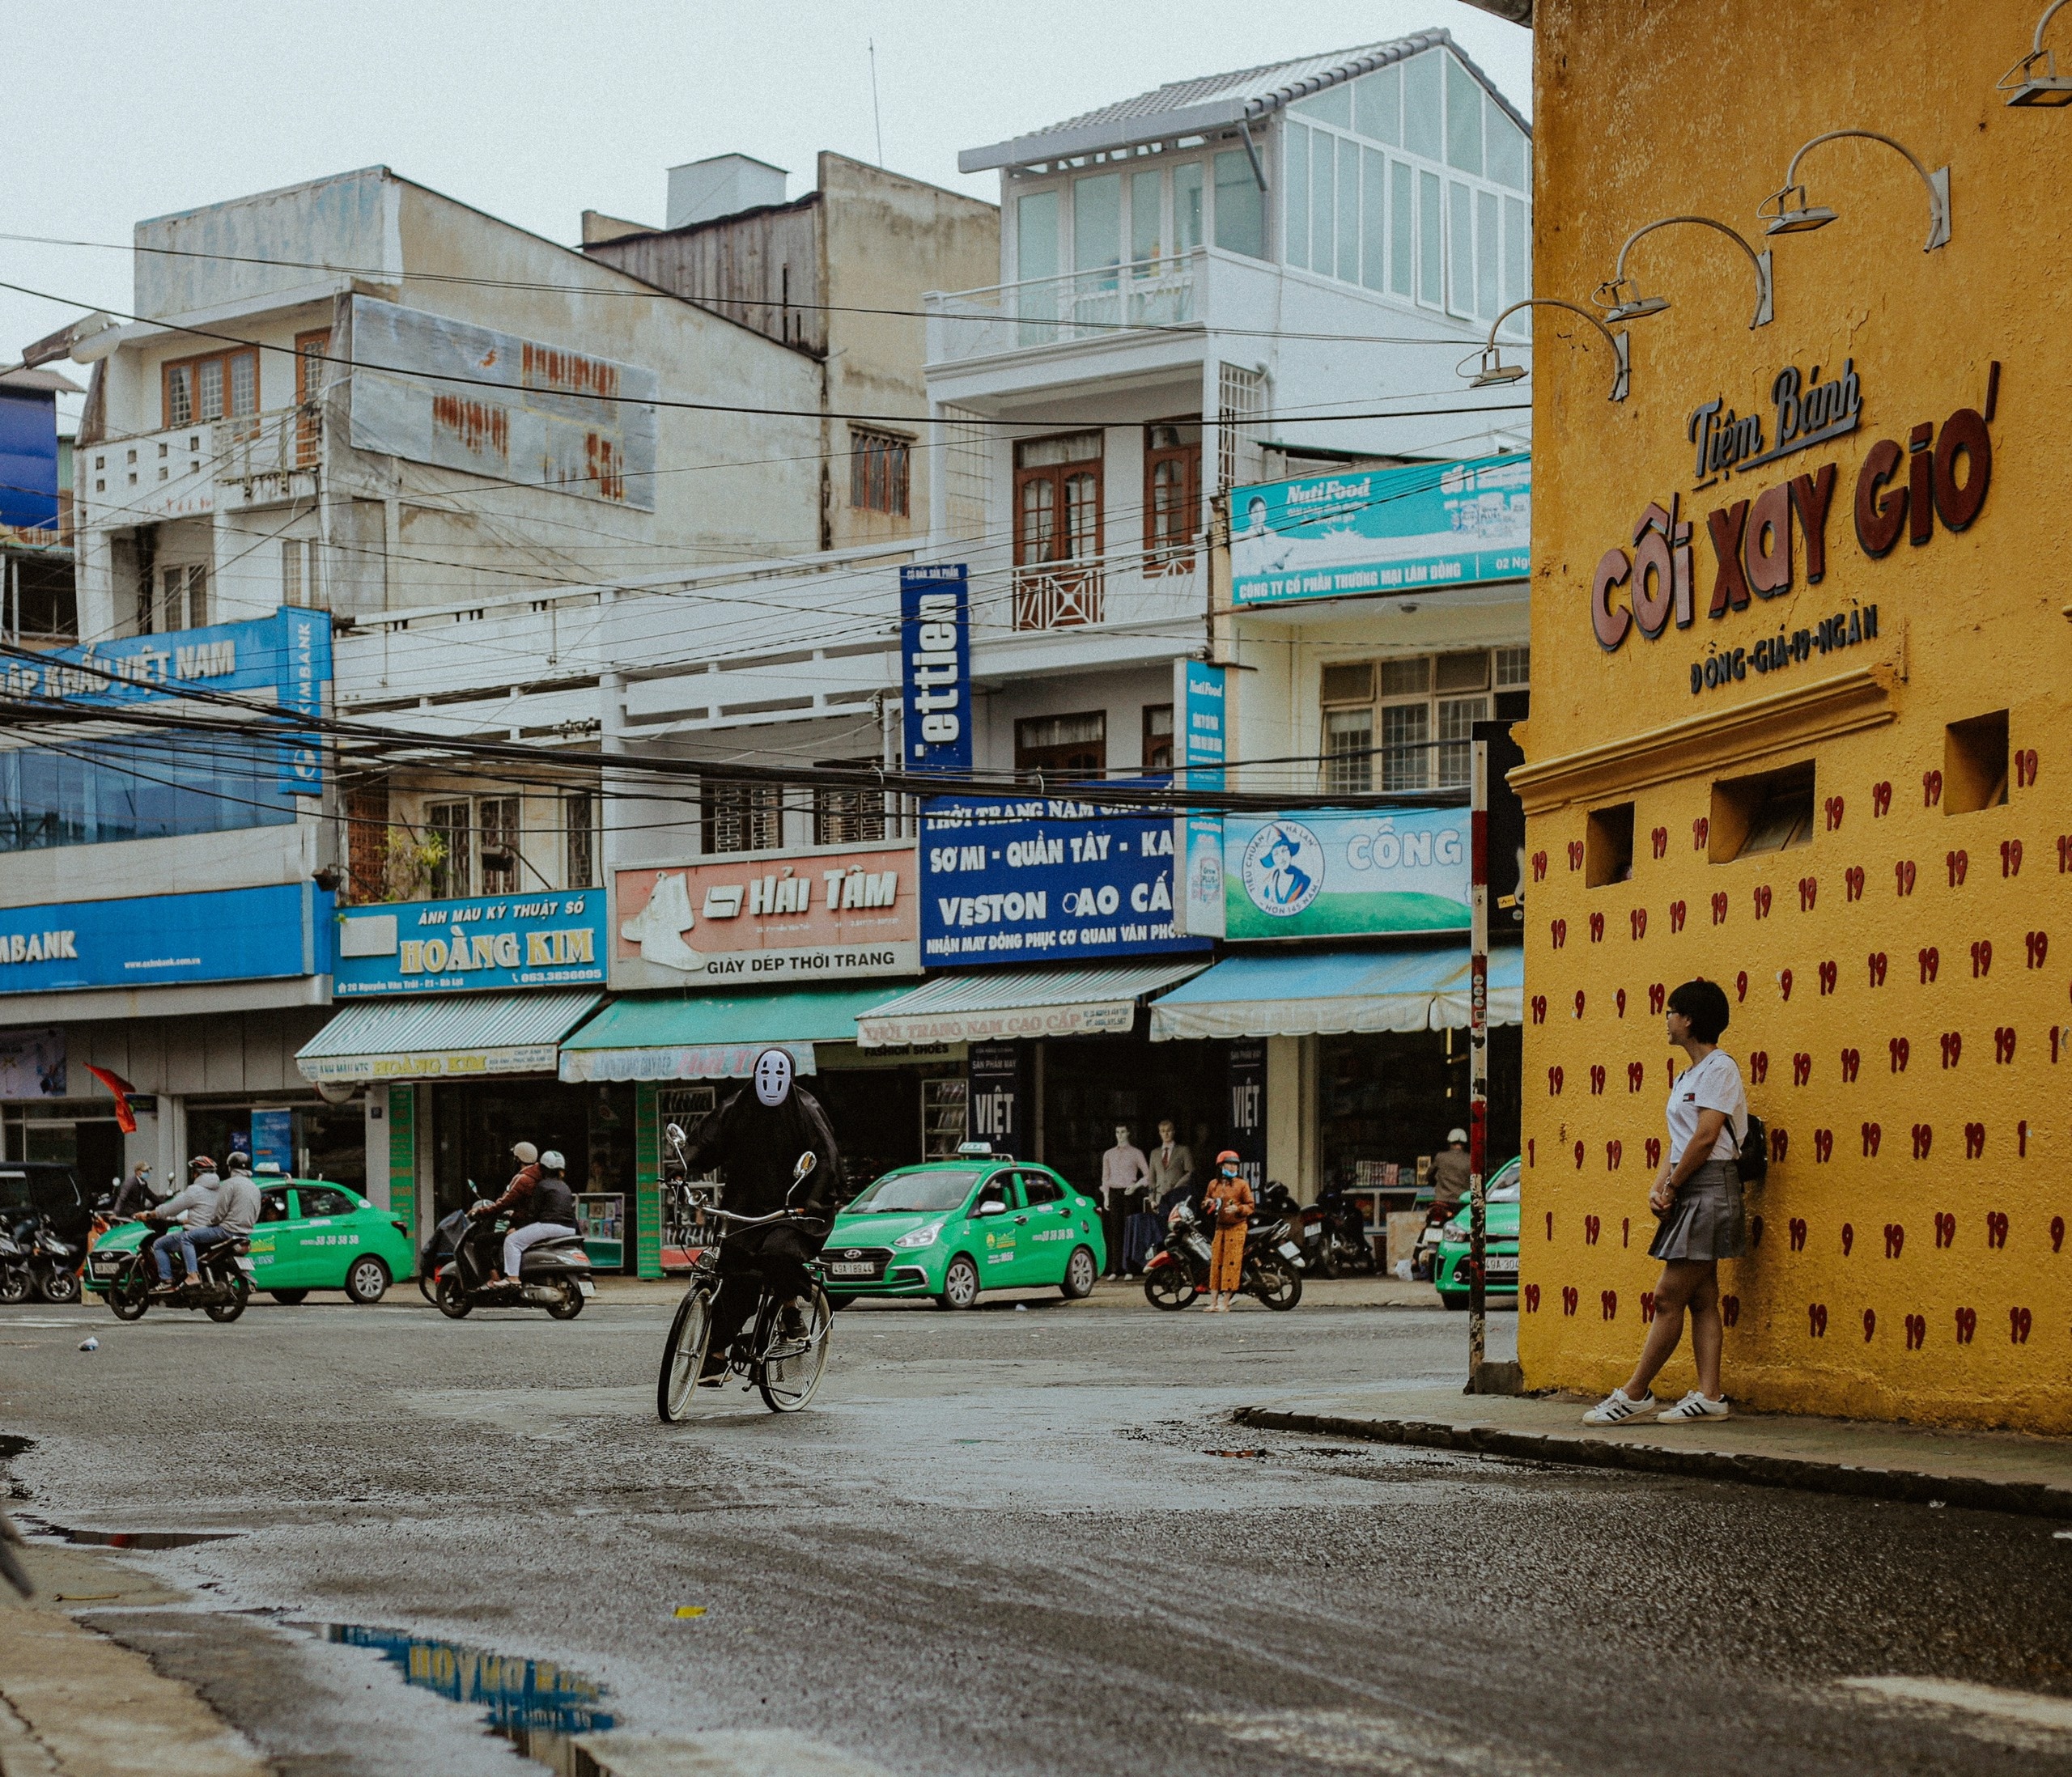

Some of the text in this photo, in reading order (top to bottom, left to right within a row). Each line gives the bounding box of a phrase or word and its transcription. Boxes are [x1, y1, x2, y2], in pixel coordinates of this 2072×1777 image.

[1688, 358, 1862, 478] Tiệm Bánh
[1271, 580, 1283, 596] TY
[116, 645, 170, 695] VIỆT
[176, 640, 236, 680] NAM
[1047, 799, 1095, 819] NAM
[1532, 749, 2039, 882] 19 19 19 19
[1007, 829, 1064, 867] QUẦN
[1070, 830, 1111, 863] TÂY
[1346, 824, 1463, 871] CÔNG
[418, 906, 447, 926] ẢNH
[452, 905, 482, 923] MÀU
[513, 899, 558, 920] THUẬT
[565, 893, 584, 914] SỐ
[748, 863, 899, 915] HẢI TÂM
[938, 891, 1047, 926] VESTON
[1131, 870, 1174, 914] CẤ
[1552, 850, 1968, 949] 19 19 19 19
[399, 925, 595, 974] HOÀNG KIM
[707, 951, 895, 975] GIÀY DÉP THỜI TRANG
[926, 936, 959, 956] NHẬN
[962, 935, 987, 953] MAY
[1025, 931, 1056, 951] PHỤC
[1081, 927, 1117, 944] QUAN
[1649, 983, 1666, 1016] 19
[1919, 947, 1939, 984] 19
[1971, 940, 1993, 978] 19
[2026, 931, 2049, 969] 19
[906, 1020, 962, 1039] TRANG
[967, 1018, 1004, 1035] NAM
[1008, 1016, 1042, 1033] CAO
[1046, 1011, 1082, 1030] CẤP
[1548, 1066, 1564, 1096] 19
[1794, 1053, 1812, 1087] 19
[1889, 1037, 1910, 1073] 19
[1994, 1027, 2017, 1064] 19
[974, 1085, 1015, 1141] VIỆT
[1233, 1076, 1260, 1135] VIỆT
[1770, 1128, 1788, 1163] 19
[1815, 1129, 1834, 1164] 19
[1912, 1124, 1933, 1160] 19
[1965, 1122, 1986, 1160] 19
[1585, 1215, 1601, 1245] 19
[1789, 1217, 1807, 1252] 19
[1884, 1224, 1905, 1259] 19
[1987, 1211, 2010, 1249] 19
[1808, 1303, 2033, 1351] 19 19 19 19
